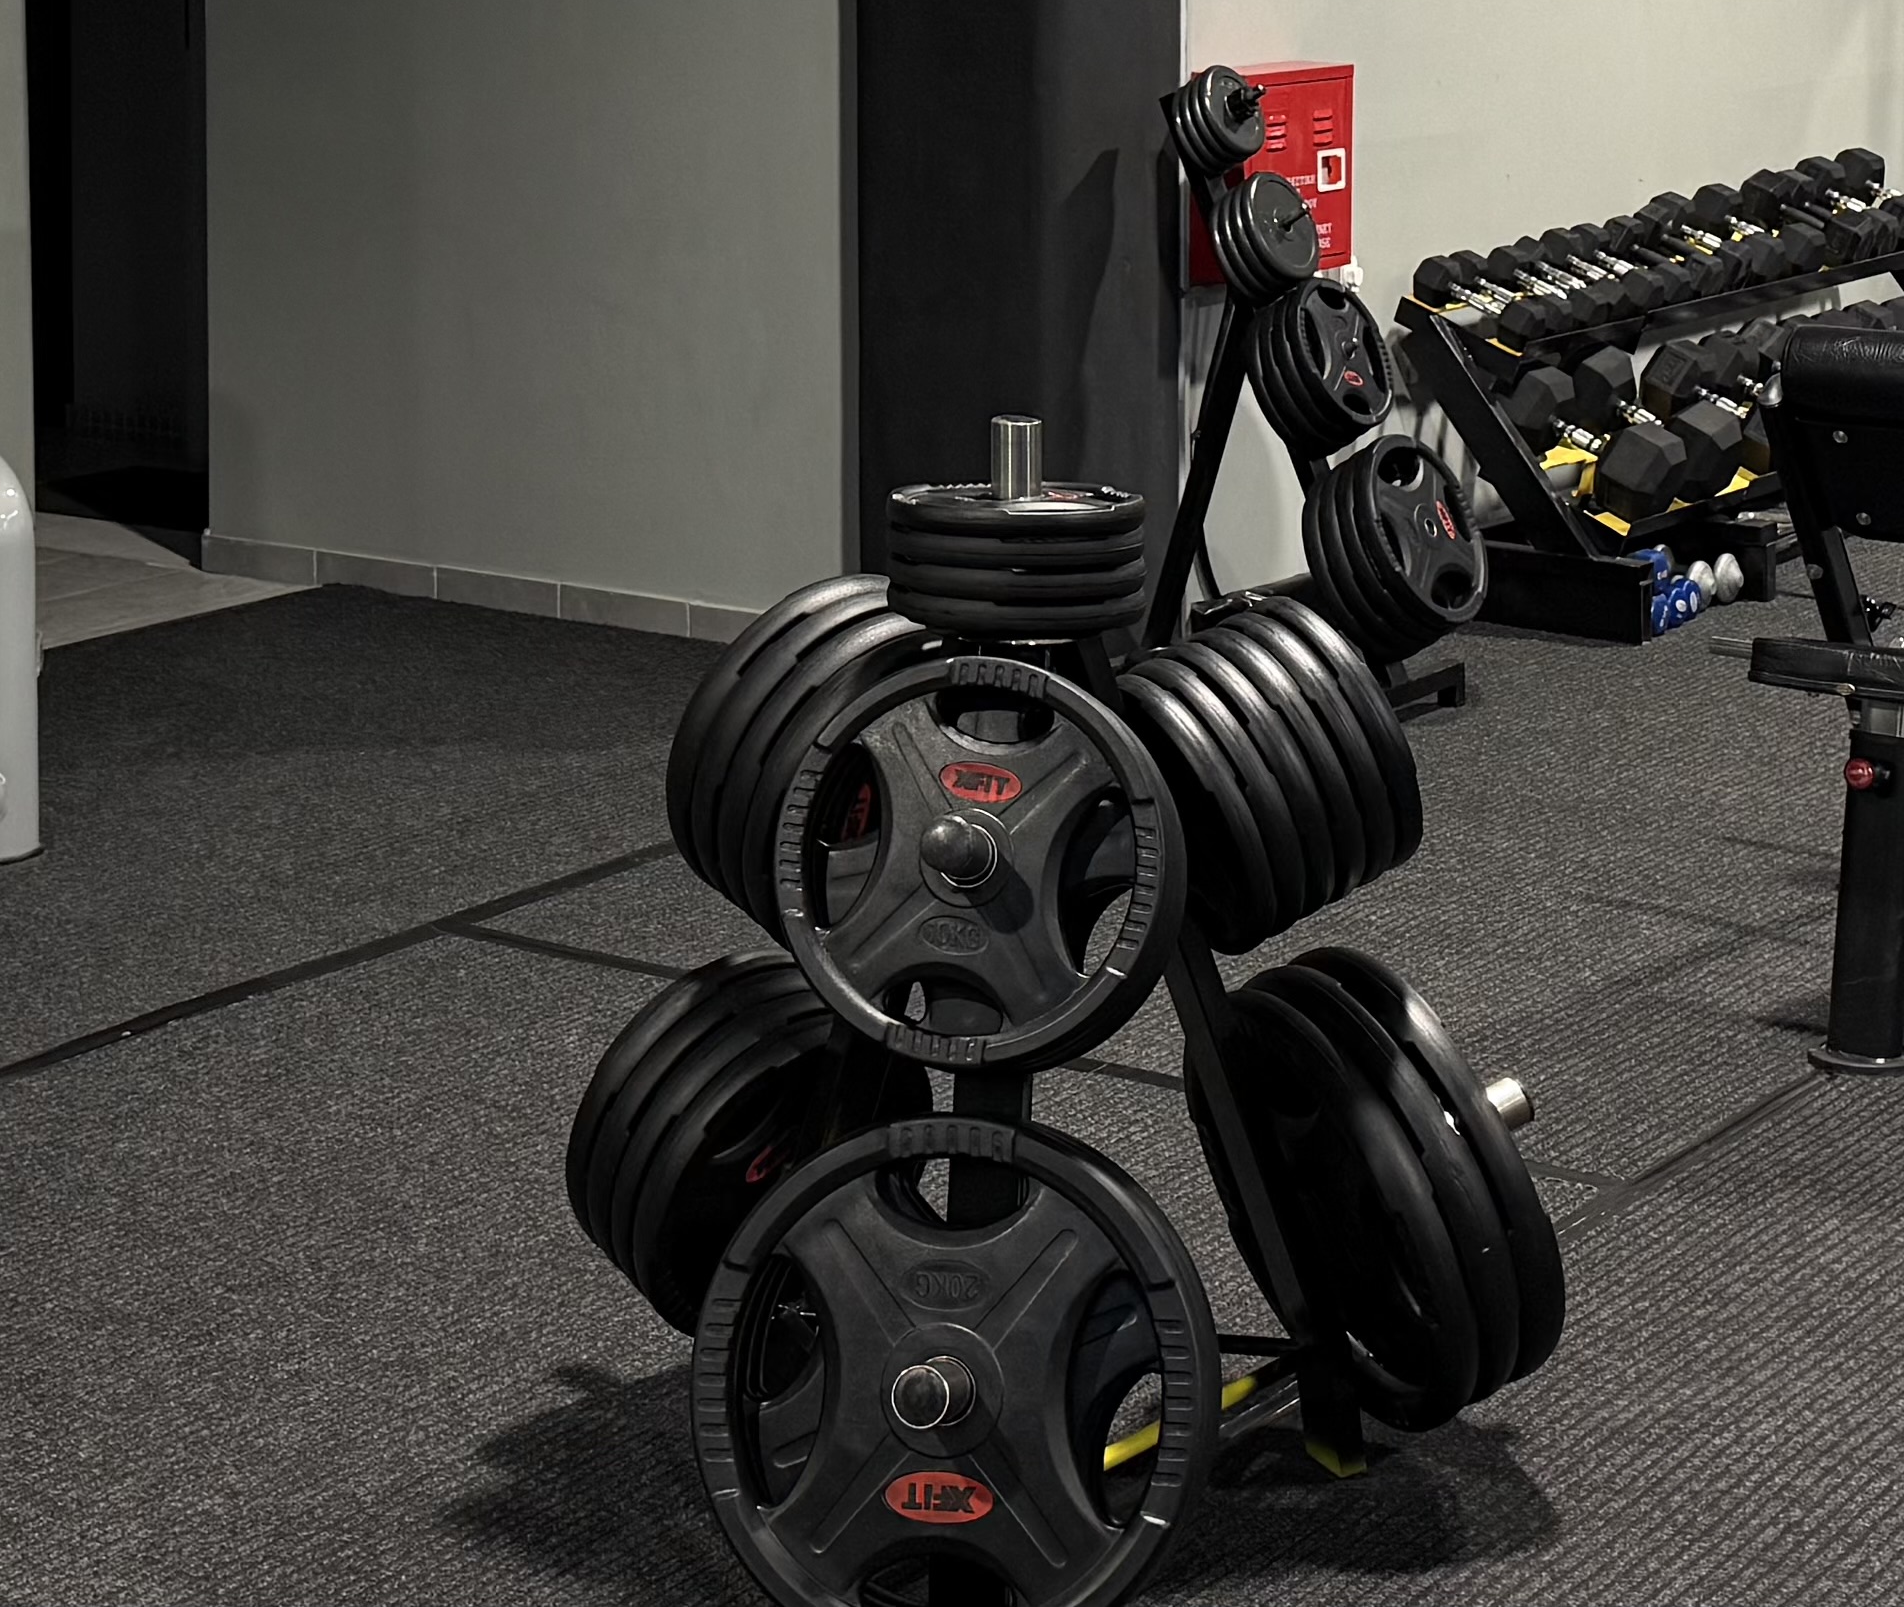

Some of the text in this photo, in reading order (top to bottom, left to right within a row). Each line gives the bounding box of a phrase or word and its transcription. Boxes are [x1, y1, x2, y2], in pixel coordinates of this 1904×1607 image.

[952, 768, 1011, 796] XFIT
[914, 1271, 979, 1298] 20KG
[901, 1482, 977, 1514] XFIT
